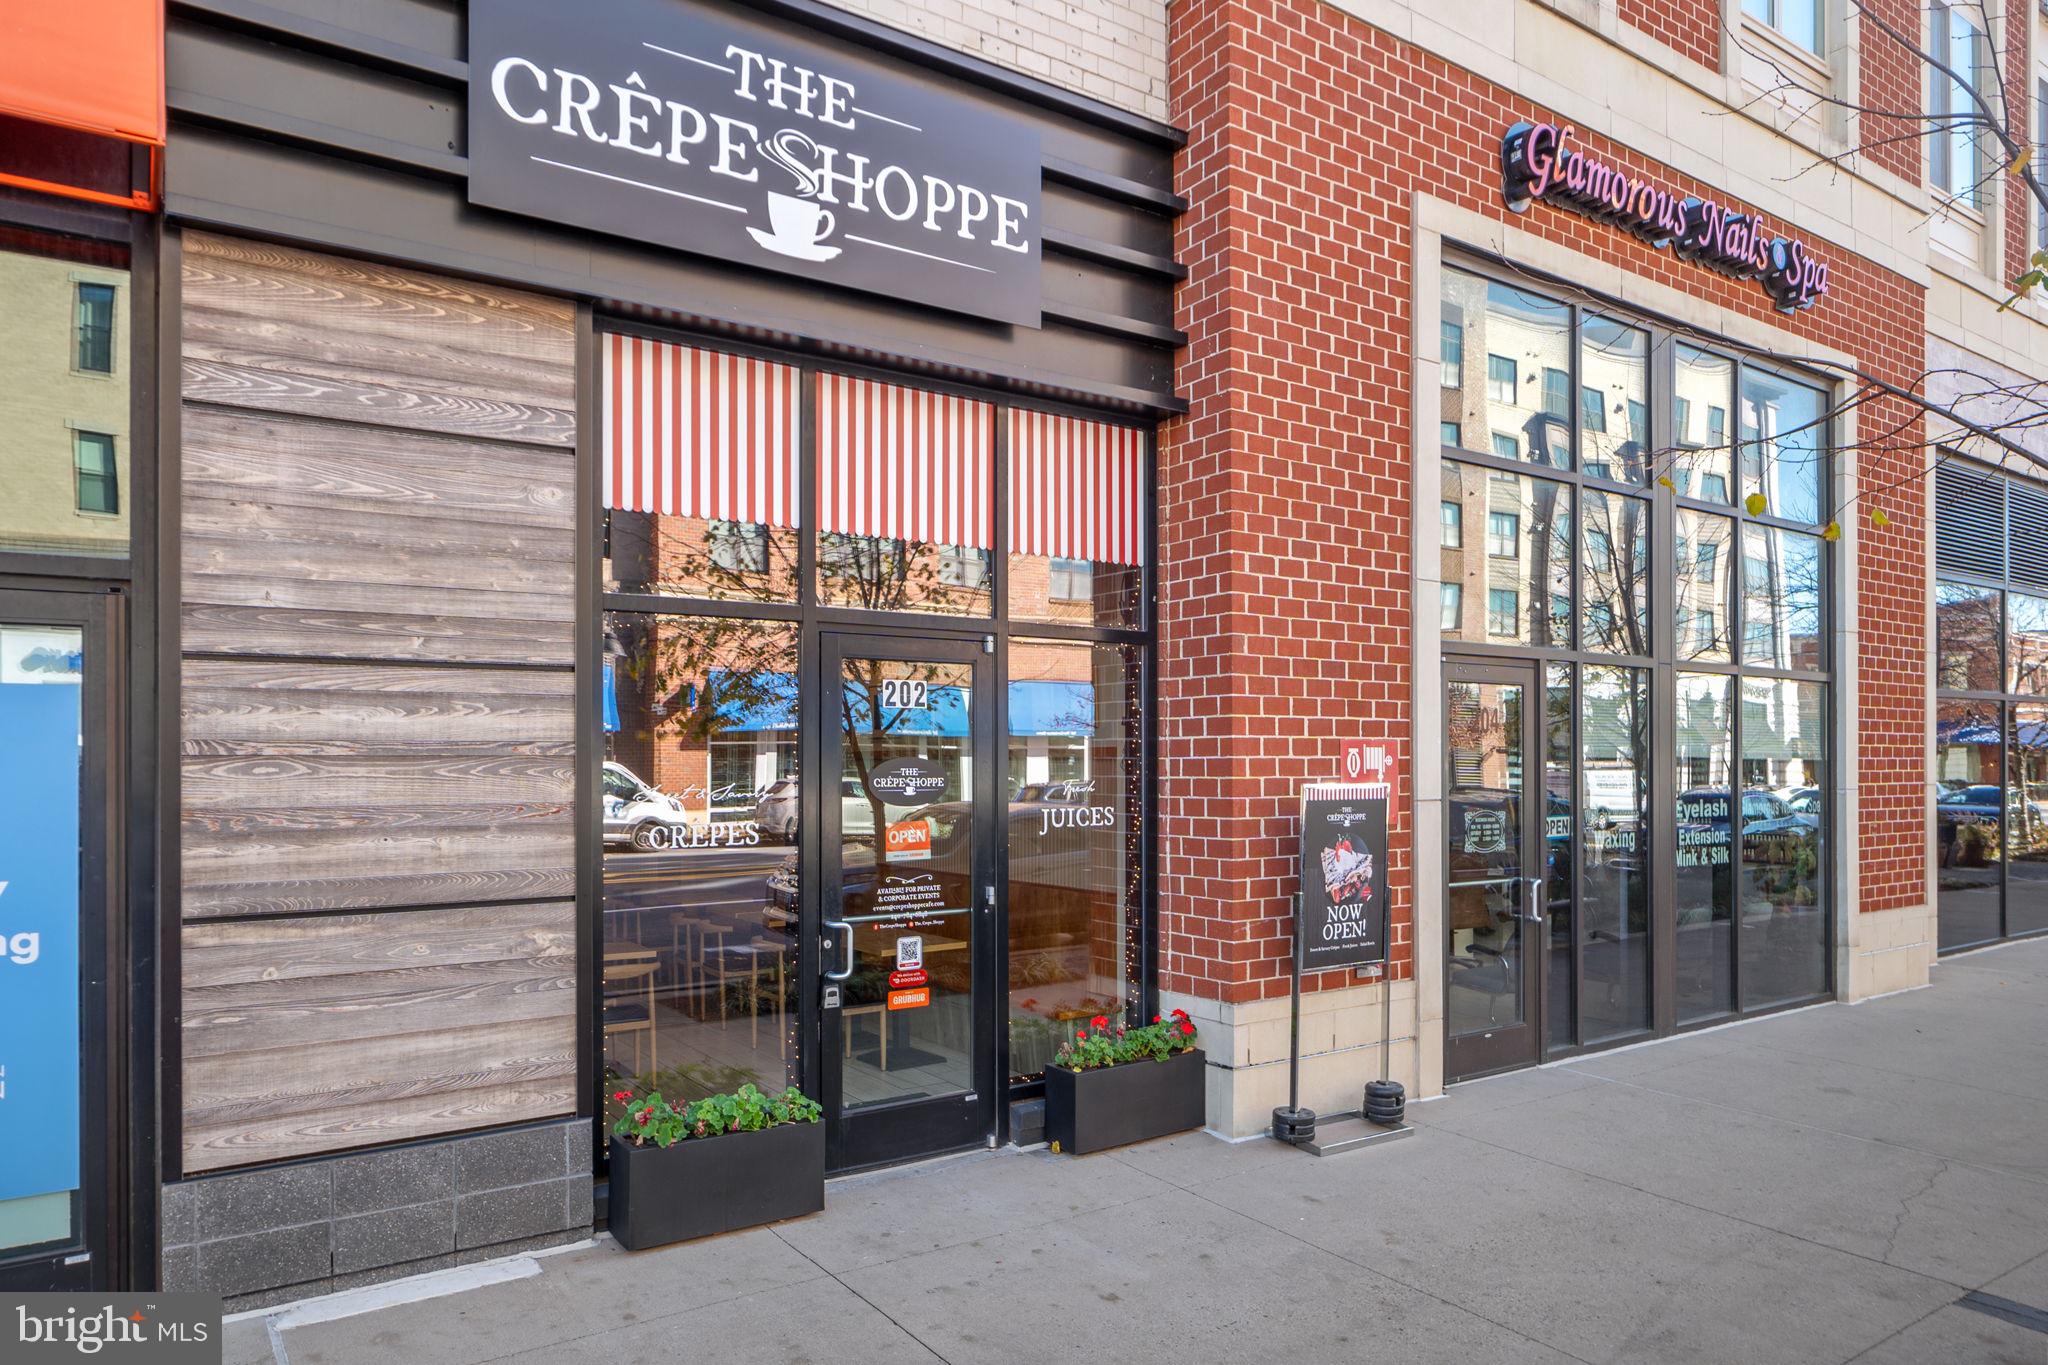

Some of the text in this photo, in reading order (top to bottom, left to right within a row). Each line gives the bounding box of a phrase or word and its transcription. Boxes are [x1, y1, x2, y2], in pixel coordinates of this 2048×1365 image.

[726, 45, 855, 130] THE
[491, 57, 1029, 254] CRÊPE SHOPPE
[1527, 122, 1829, 303] Glamorous Nails Spa
[884, 680, 926, 707] 202
[900, 768, 919, 776] THE
[905, 776, 944, 788] SHOPPE
[1062, 779, 1096, 796] Fresh
[1676, 798, 1728, 822] Eyelash
[1039, 806, 1115, 836] JUICES
[888, 828, 927, 844] OPEN
[1678, 827, 1726, 846] Extension
[1701, 849, 1708, 866] &
[1711, 846, 1730, 865] Silk
[883, 893, 918, 902] CORPORATE
[917, 892, 940, 900] EVENTS
[905, 885, 917, 893] FOR
[917, 884, 941, 892] PRIVATE
[1326, 903, 1364, 923] NOW
[1322, 918, 1367, 941] OPEN!
[892, 993, 926, 1005] GRUBHUB
